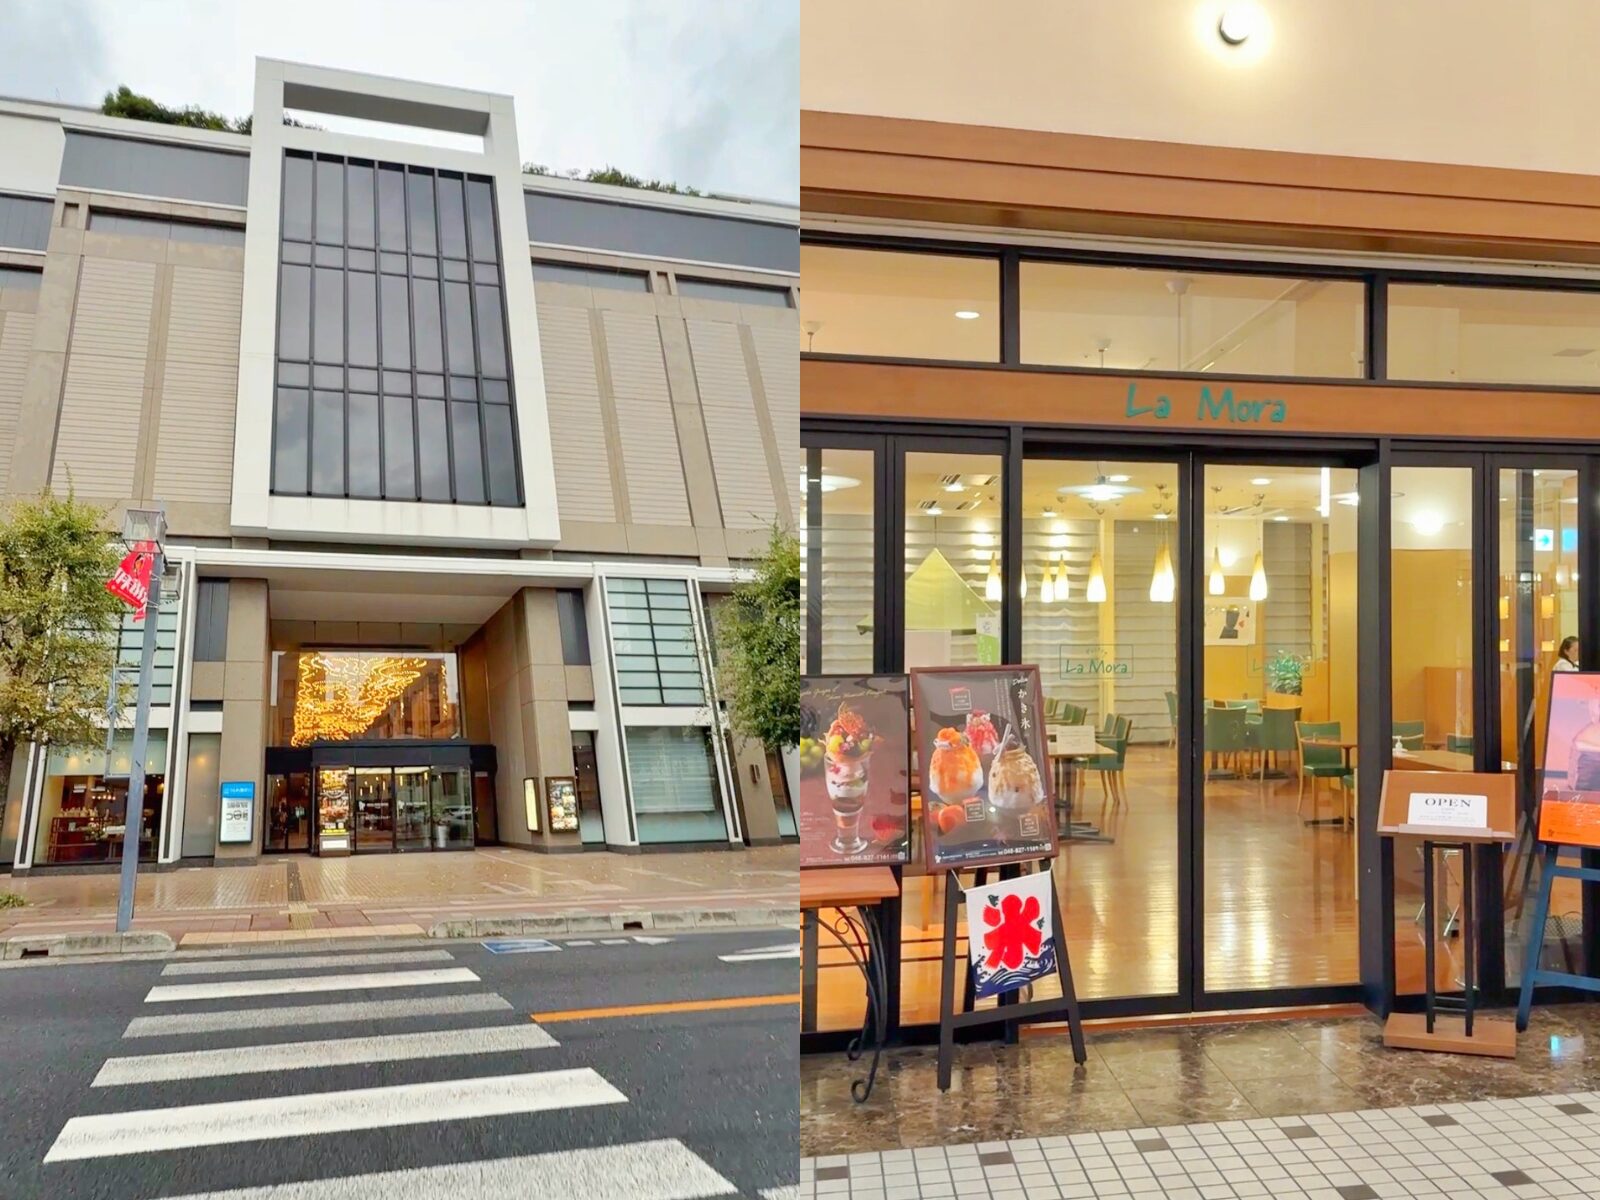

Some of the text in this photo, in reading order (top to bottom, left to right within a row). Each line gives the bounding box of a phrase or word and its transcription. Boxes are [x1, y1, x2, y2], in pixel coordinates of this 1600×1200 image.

[1125, 382, 1287, 423] La Mora
[1065, 658, 1128, 674] La Mora
[1425, 797, 1472, 808] OPEN
[983, 894, 1042, 970] 氷
